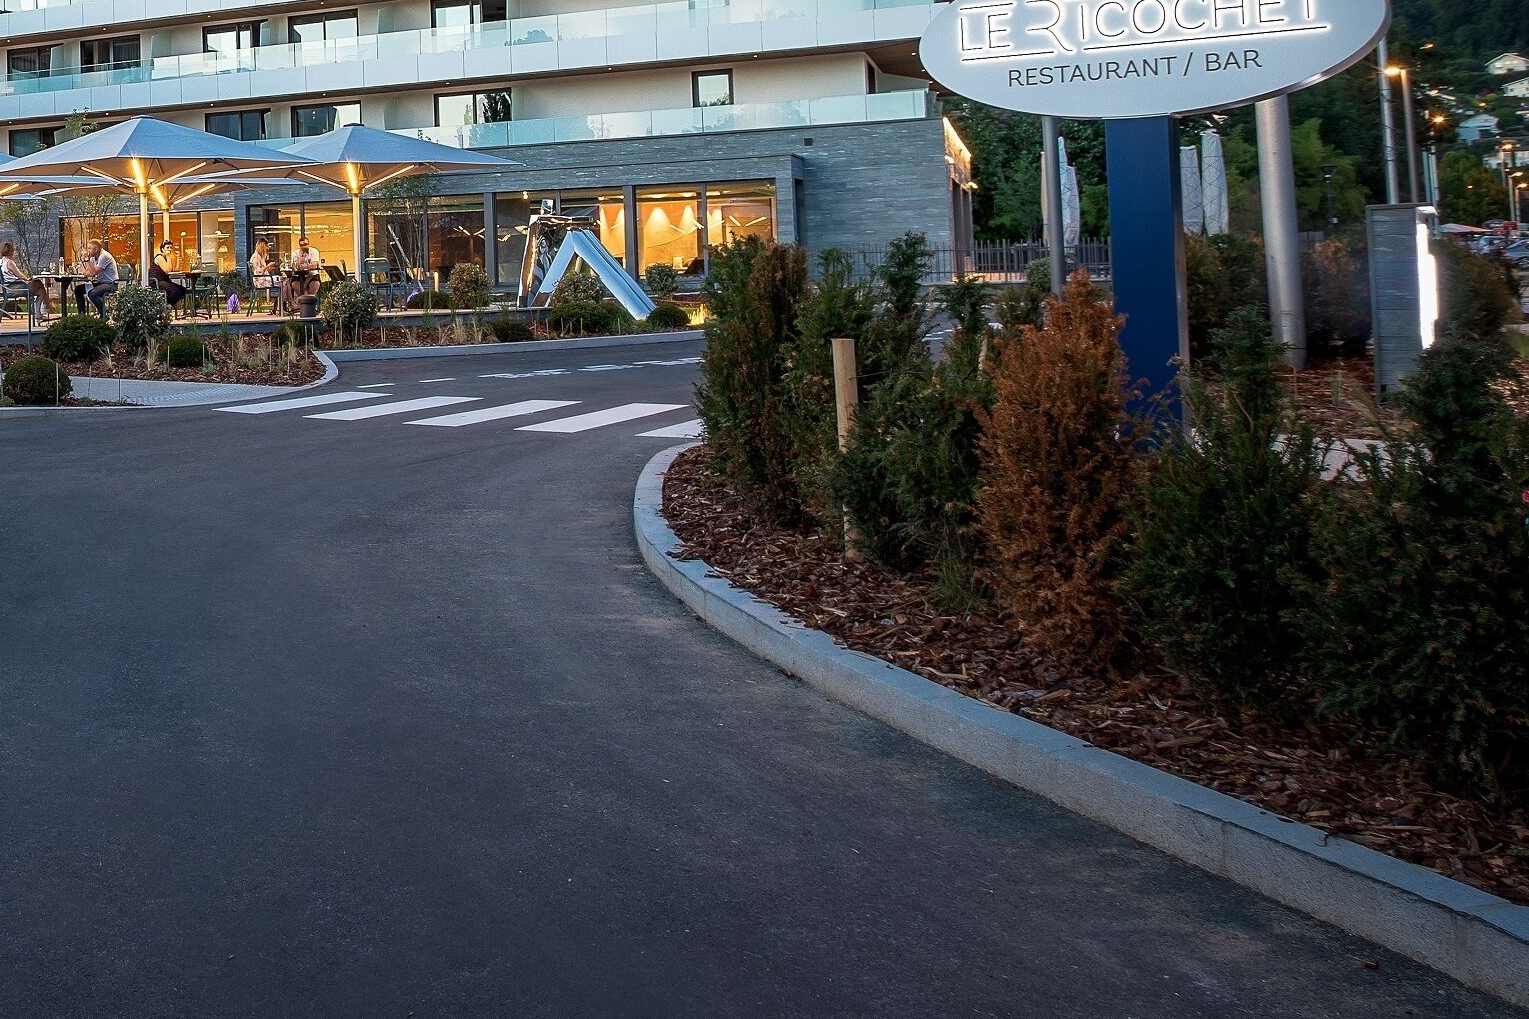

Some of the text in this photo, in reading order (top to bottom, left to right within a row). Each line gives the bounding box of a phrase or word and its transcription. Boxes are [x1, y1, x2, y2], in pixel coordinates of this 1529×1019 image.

[960, 12, 1011, 51] LE
[1008, 56, 1177, 87] RESTAURANT
[1205, 49, 1262, 72] BAR
